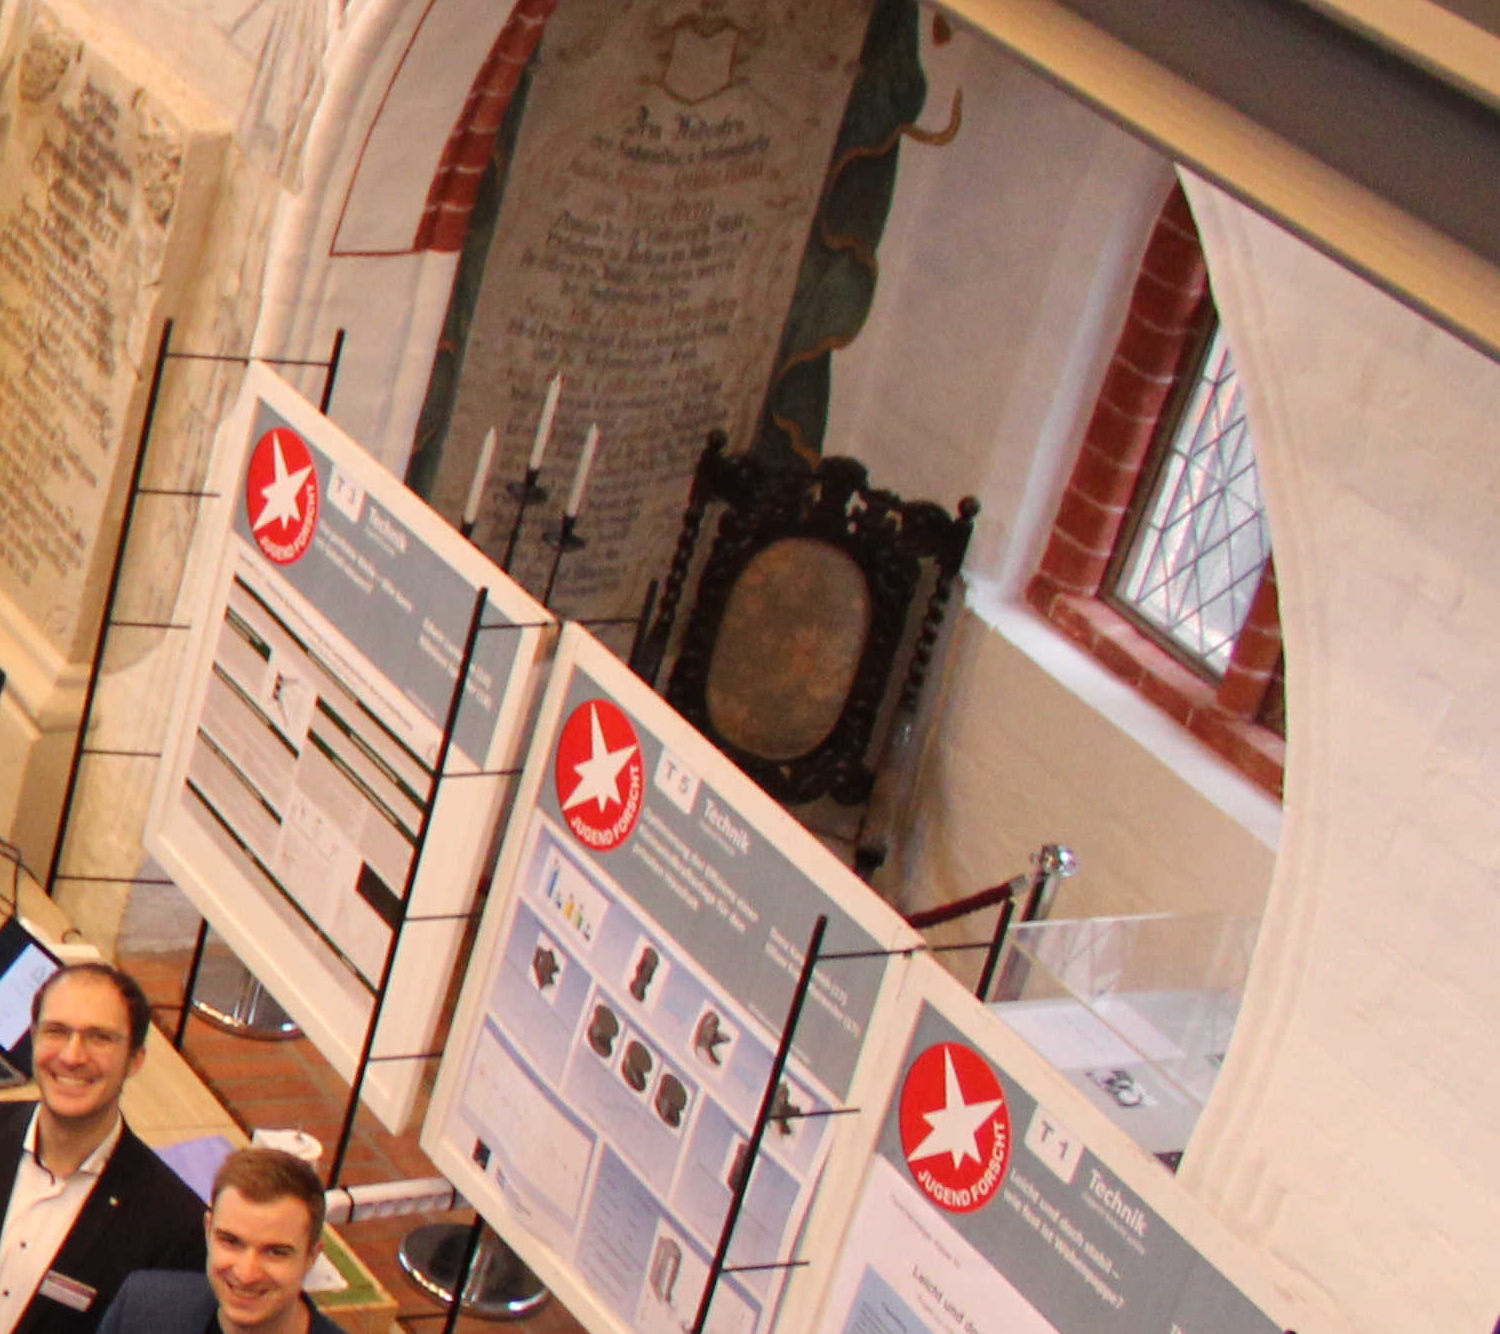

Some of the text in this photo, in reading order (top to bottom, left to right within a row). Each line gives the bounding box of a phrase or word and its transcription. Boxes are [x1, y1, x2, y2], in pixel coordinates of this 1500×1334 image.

[570, 815, 613, 847] JUGEND
[612, 764, 641, 841] FORSCHT
[704, 798, 751, 855] Technik
[917, 1120, 1007, 1207] JUGEND FORSCHT
[1039, 1120, 1071, 1160] T 1
[1088, 1169, 1148, 1237] Technik
[911, 1264, 943, 1305] Leicht
[941, 1296, 965, 1325] und
